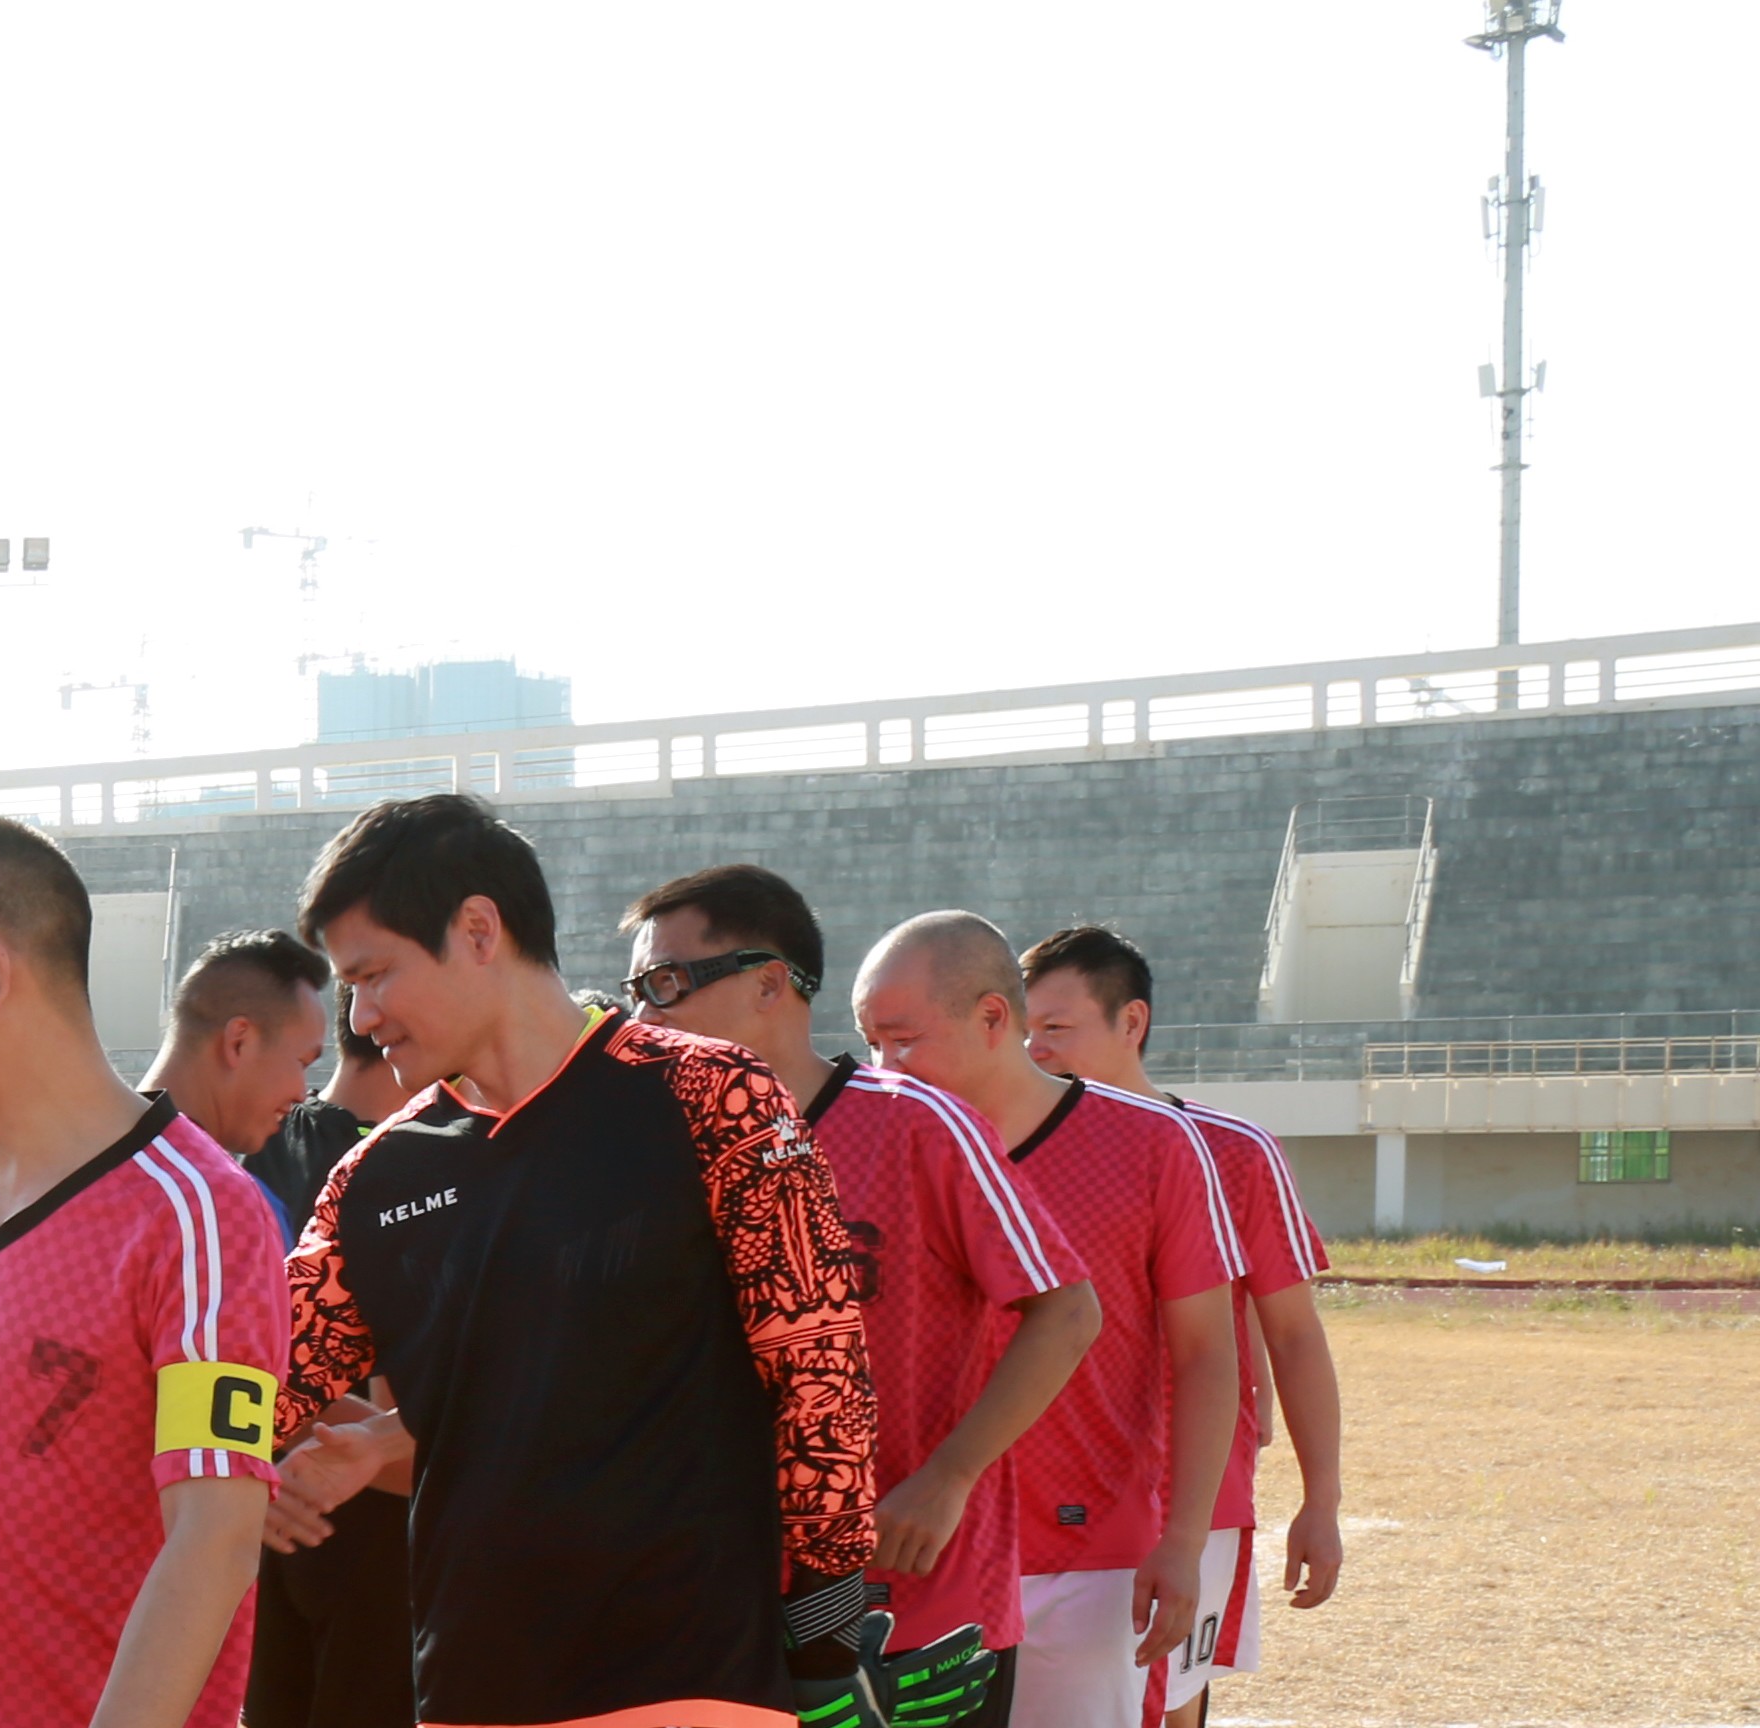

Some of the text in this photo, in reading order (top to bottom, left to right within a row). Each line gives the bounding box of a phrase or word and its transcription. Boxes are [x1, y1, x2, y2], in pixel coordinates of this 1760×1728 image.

[762, 1142, 813, 1165] KELME
[379, 1187, 459, 1228] KELME
[19, 1336, 102, 1460] 7
[210, 1375, 263, 1445] C
